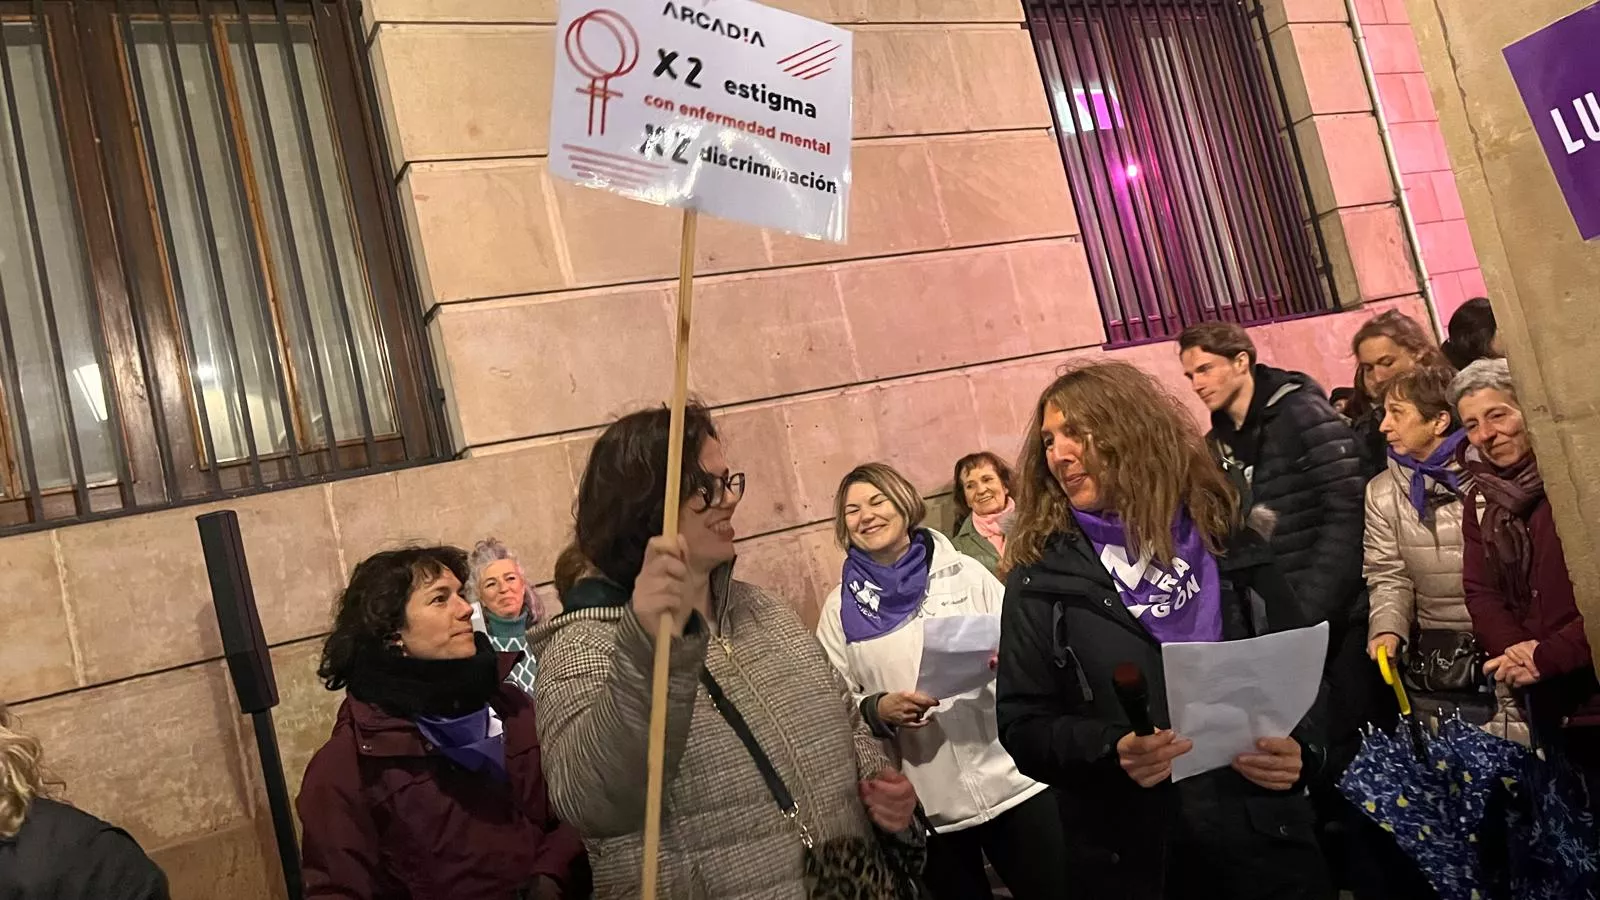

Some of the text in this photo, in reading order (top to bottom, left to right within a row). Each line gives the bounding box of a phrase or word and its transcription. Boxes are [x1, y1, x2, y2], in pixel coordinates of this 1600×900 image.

[643, 93, 831, 156] con enfermedad mental
[724, 79, 817, 119] estigma
[699, 144, 837, 195] discriminación
